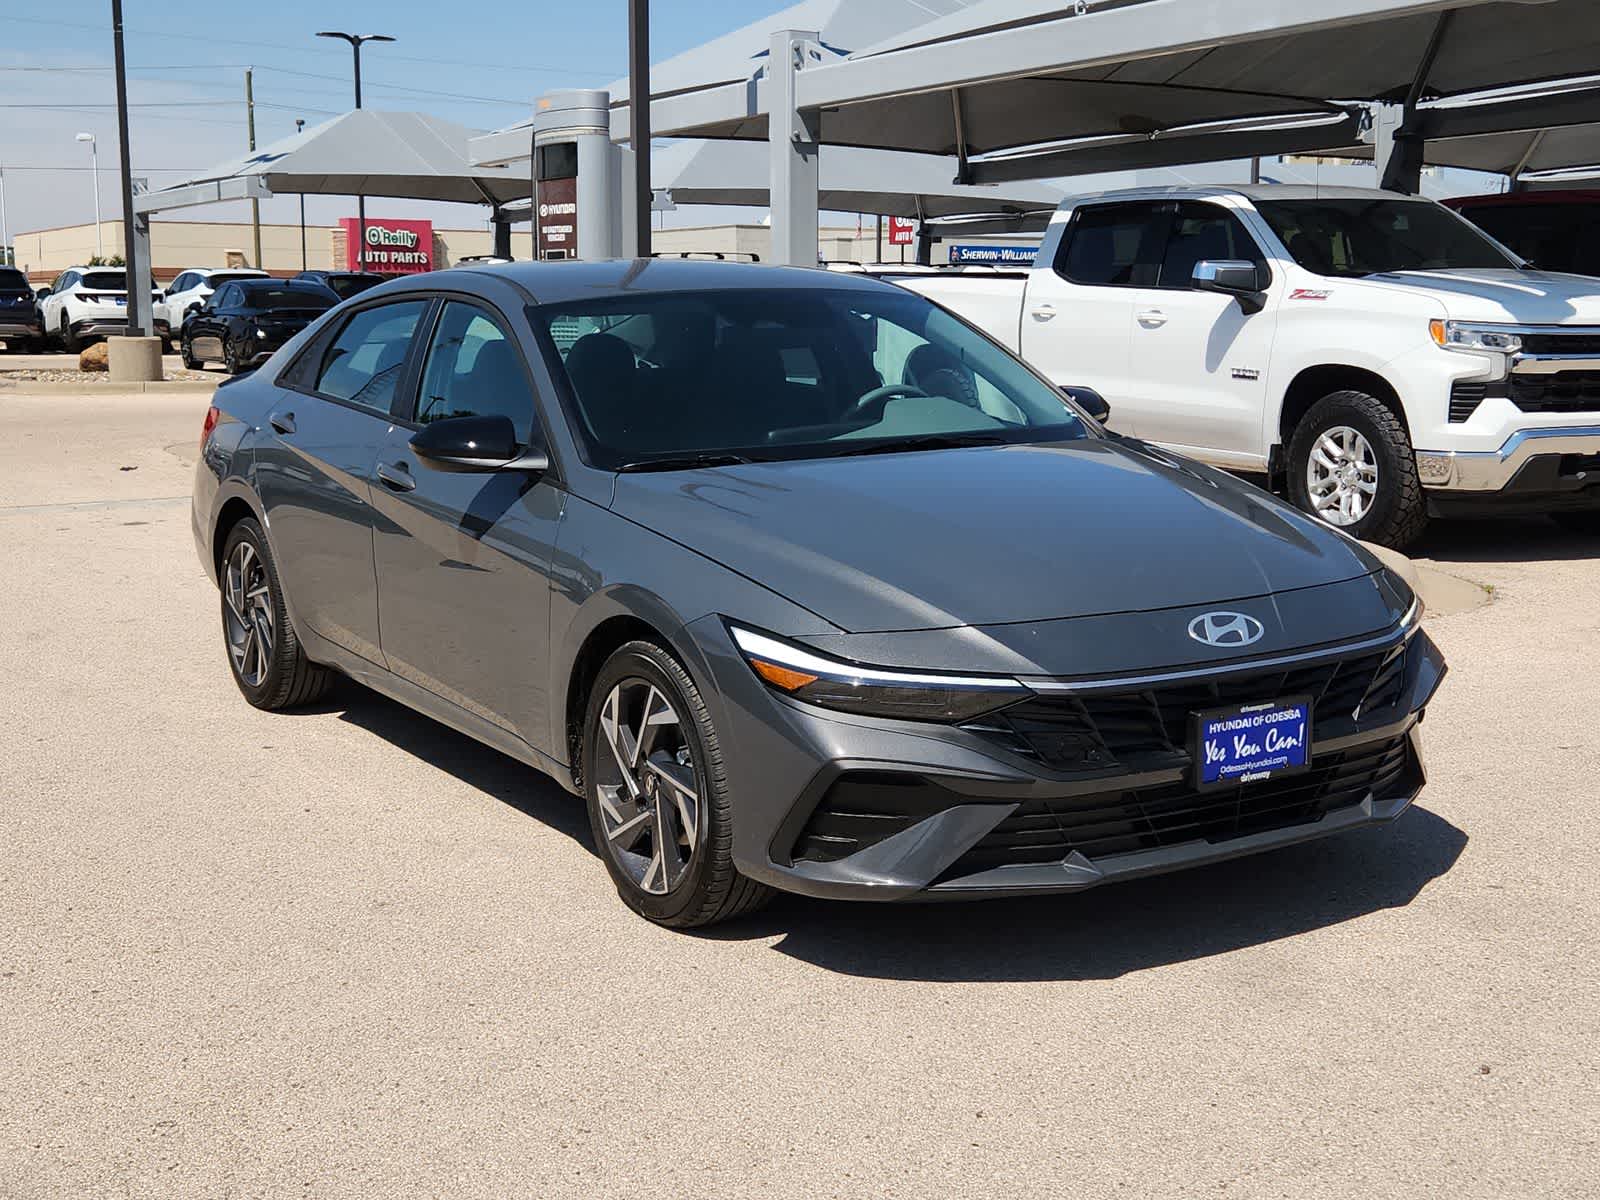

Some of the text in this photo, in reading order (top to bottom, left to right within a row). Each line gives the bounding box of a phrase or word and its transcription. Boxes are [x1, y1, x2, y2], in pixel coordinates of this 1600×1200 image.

[549, 203, 576, 215] HYUNDAI
[367, 226, 417, 247] O'Reilly
[391, 251, 428, 264] PARTS
[1209, 709, 1301, 734] HYUNDAI OF ODESSA
[1205, 722, 1304, 765] Yes You Can!
